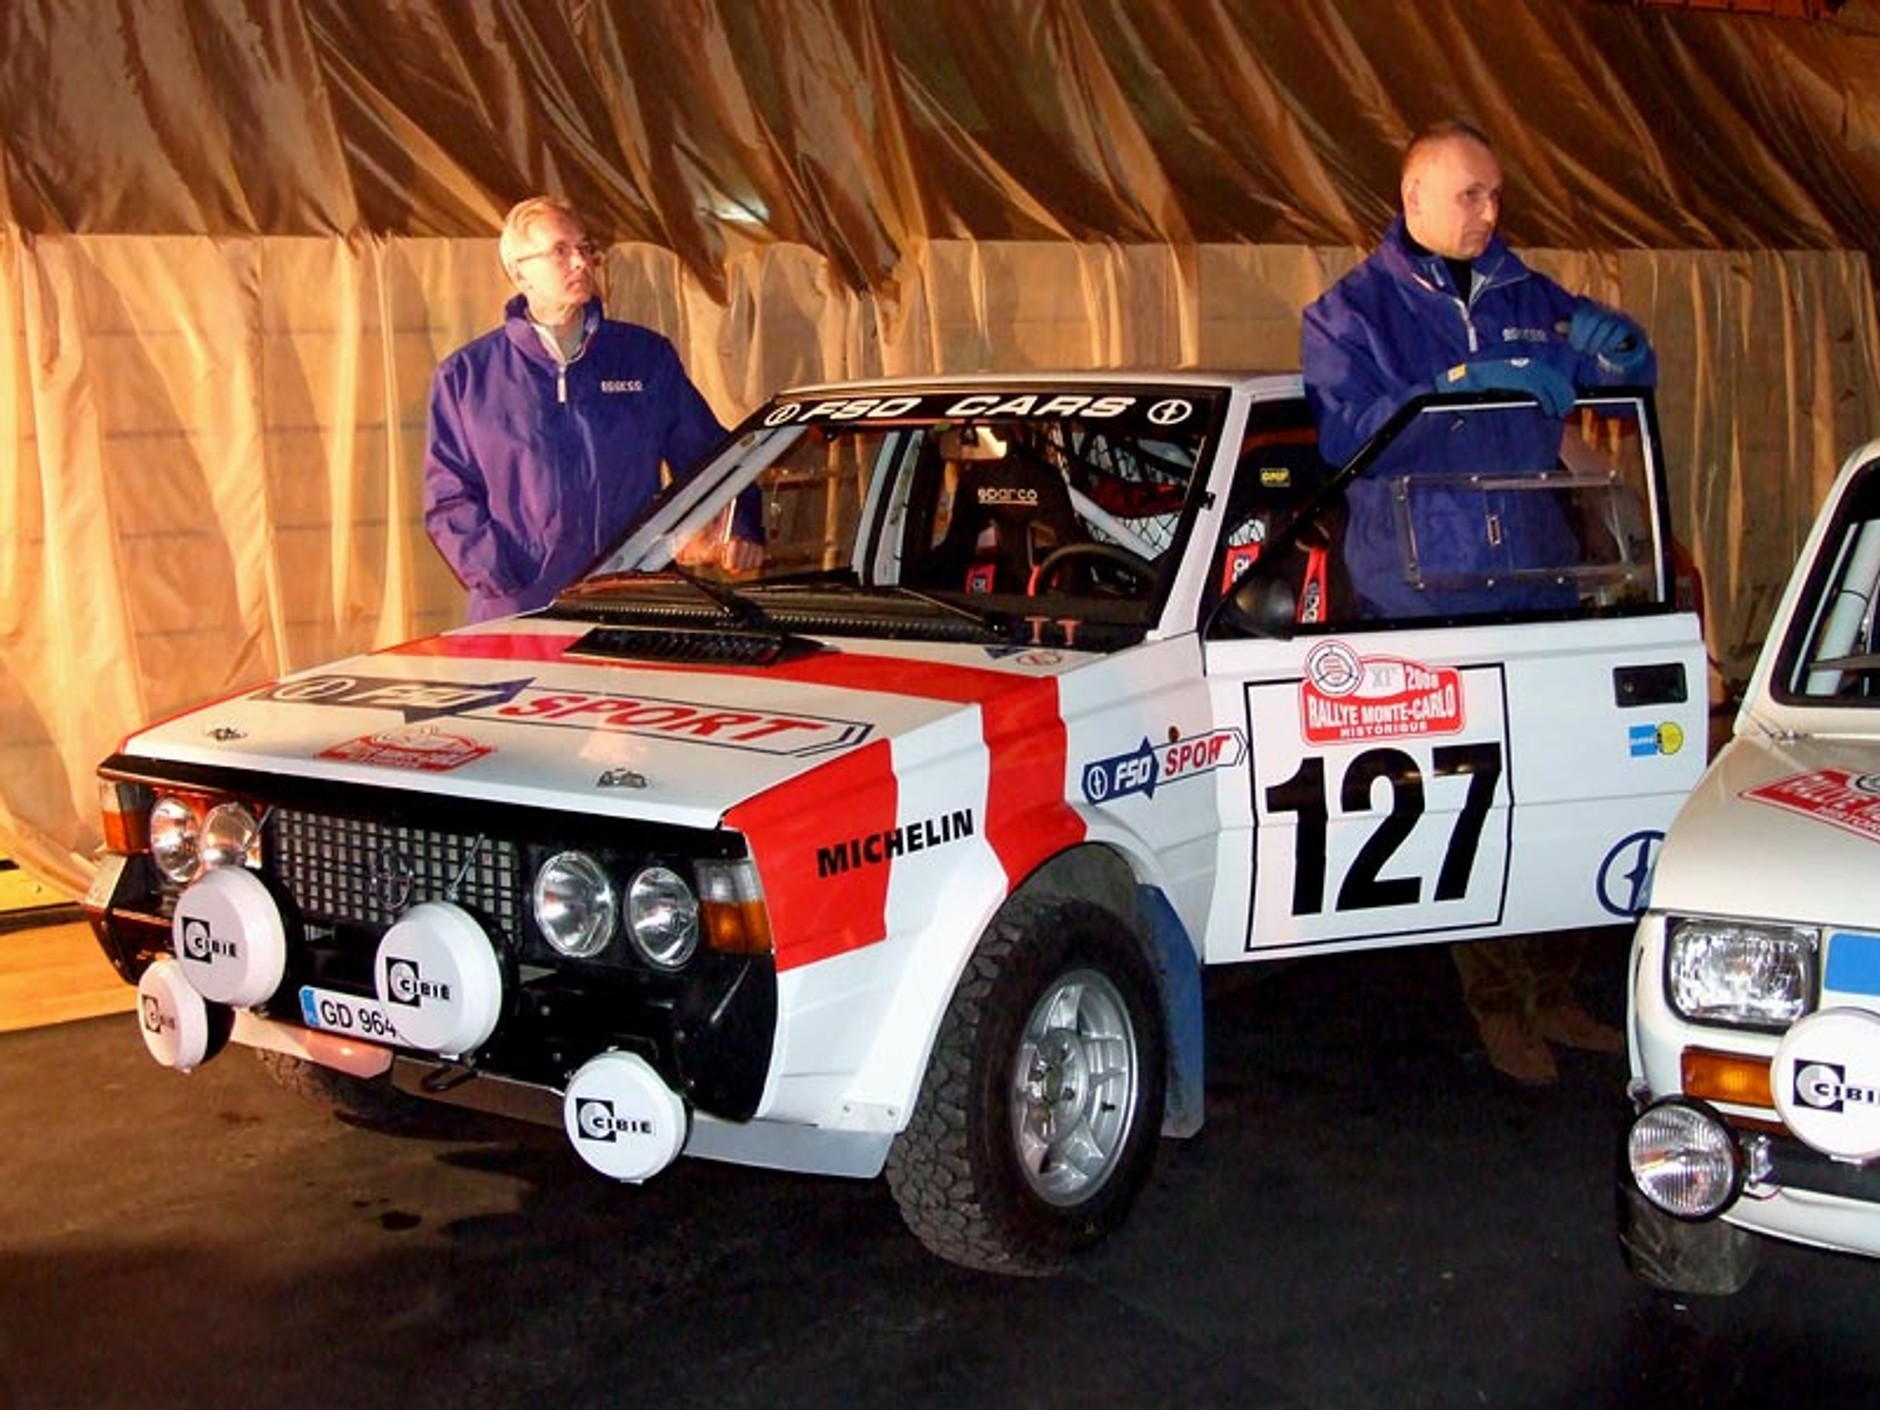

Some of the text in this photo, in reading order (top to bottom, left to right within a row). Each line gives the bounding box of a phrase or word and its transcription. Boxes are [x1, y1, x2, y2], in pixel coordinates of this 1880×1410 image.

[798, 396, 1136, 422] FSO CARS
[502, 694, 825, 742] SPORT
[1307, 683, 1456, 729] RALLYE MONTE-CARLO
[1340, 721, 1428, 738] HISTORIQUE
[1113, 734, 1231, 791] FSO SPORT
[817, 808, 974, 878] MICHELIN
[1266, 742, 1502, 915] 127
[400, 979, 450, 1000] CIBIE
[320, 1000, 354, 1029] GD
[1814, 1083, 1880, 1104] CIBI
[592, 1117, 651, 1134] CIBIE
